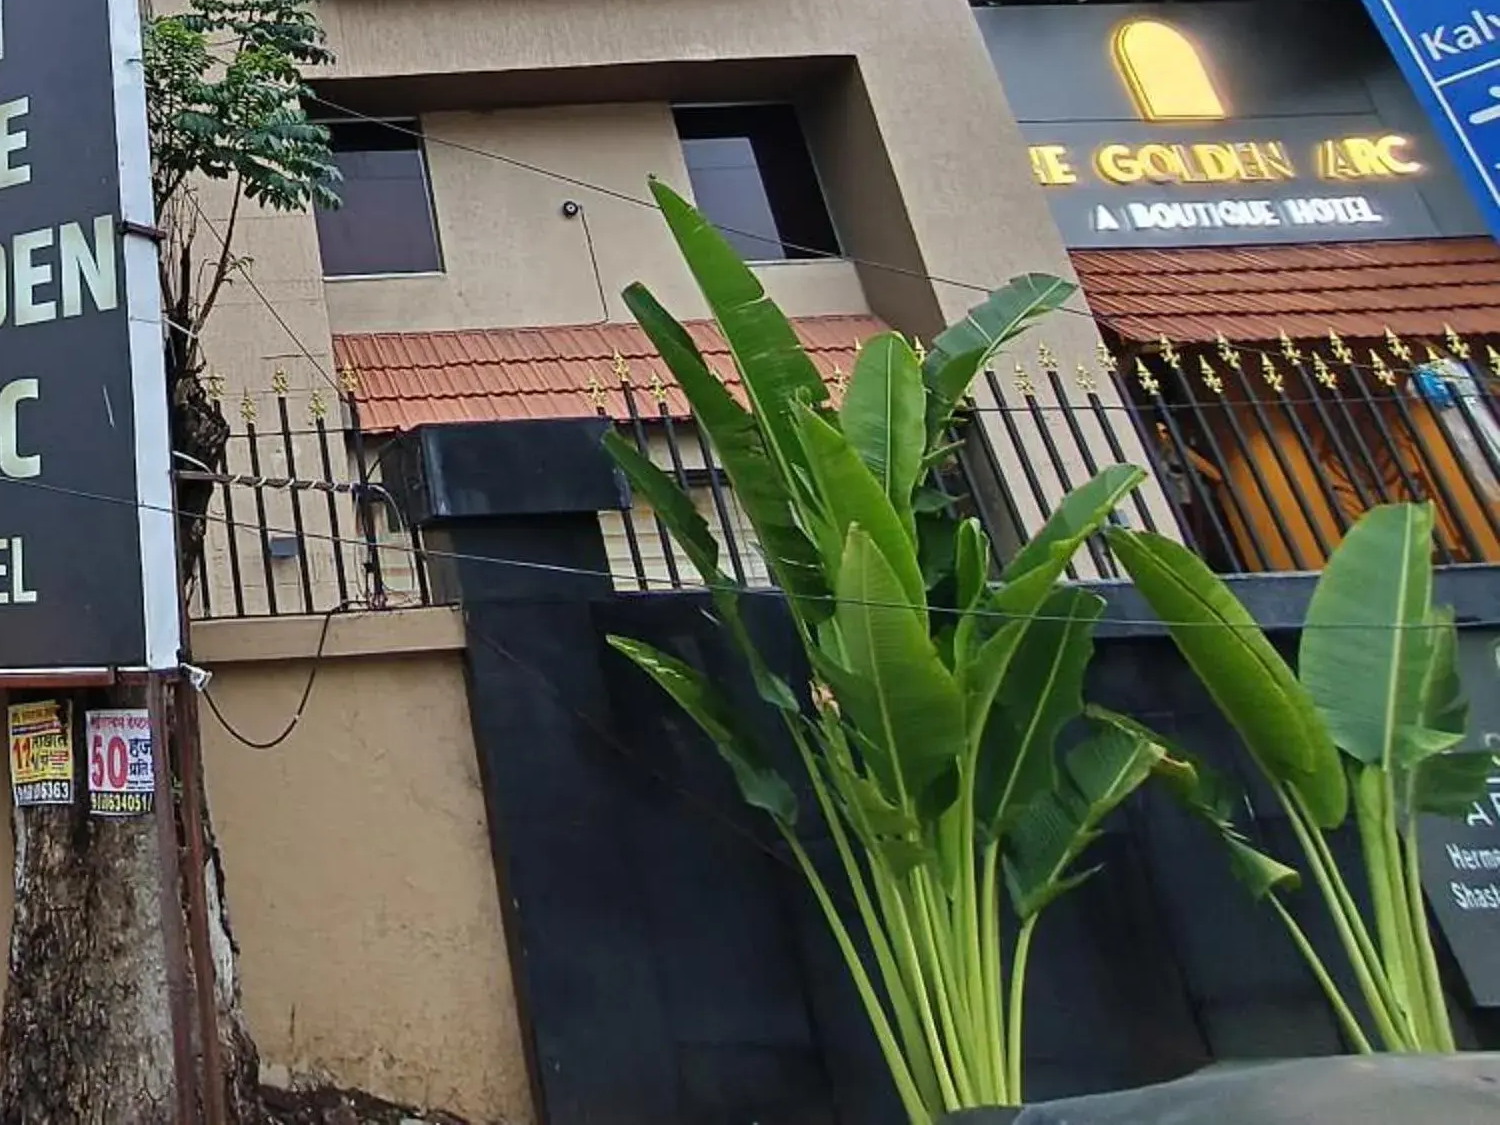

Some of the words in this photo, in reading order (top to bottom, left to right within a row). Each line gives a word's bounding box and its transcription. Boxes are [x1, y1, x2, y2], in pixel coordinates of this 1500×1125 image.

[1092, 140, 1296, 186] GOLDEN
[1317, 135, 1422, 179] ARC
[1091, 203, 1120, 230] A
[1124, 200, 1281, 230] BOUTIQUE
[1284, 196, 1383, 224] HOTEL
[92, 733, 129, 789] 50
